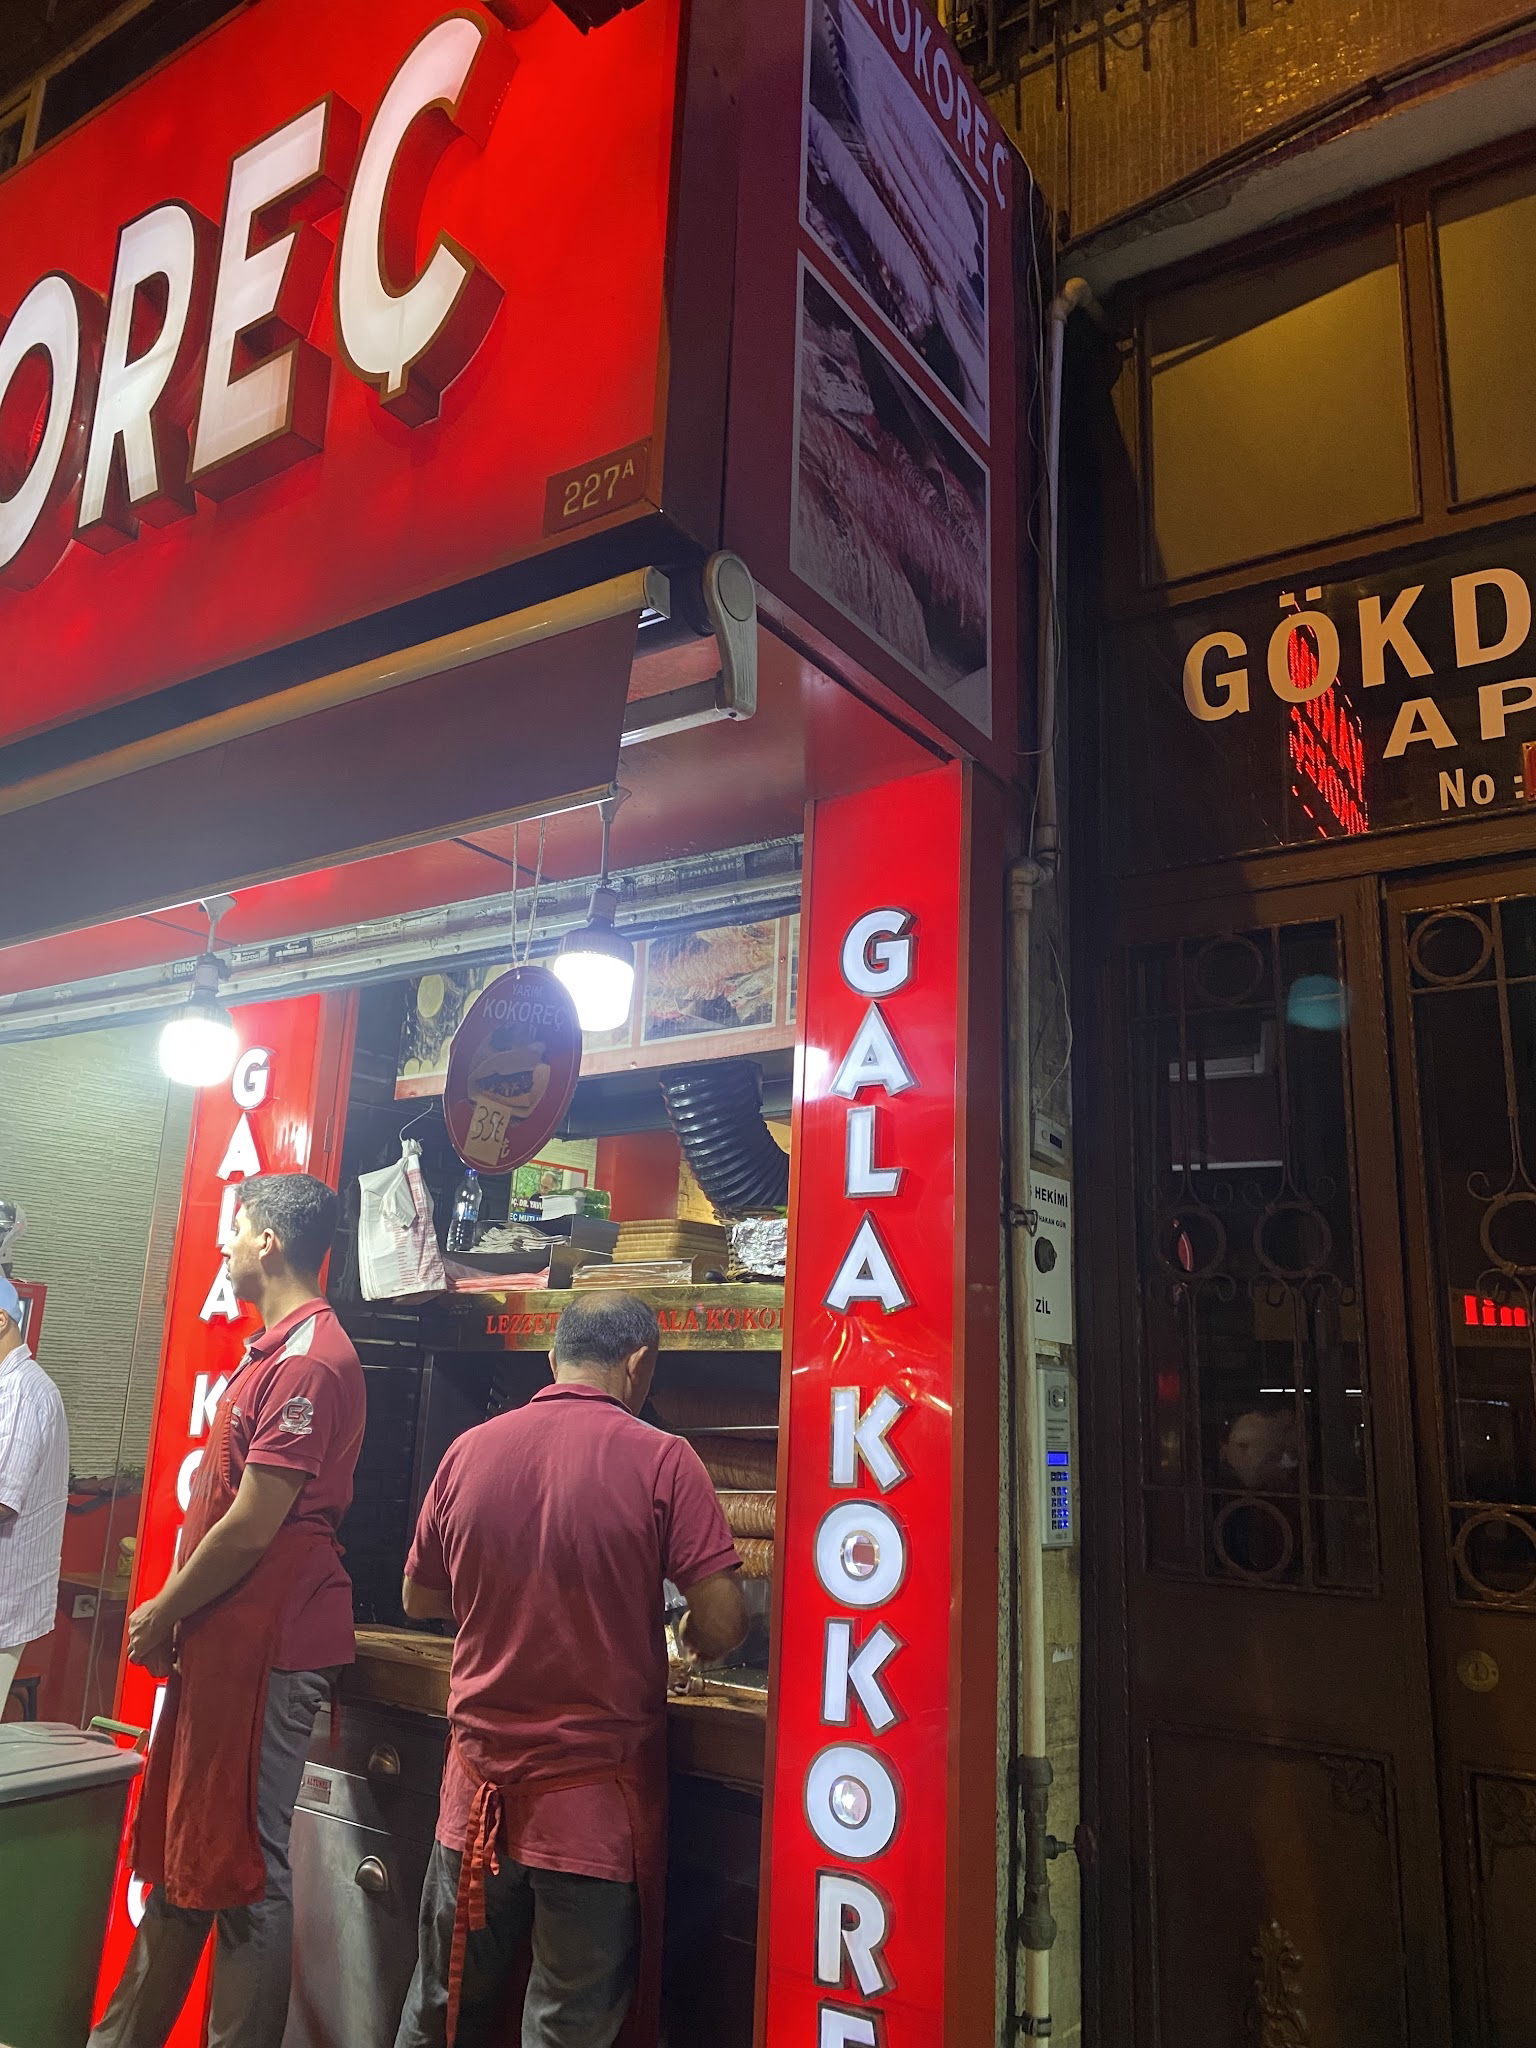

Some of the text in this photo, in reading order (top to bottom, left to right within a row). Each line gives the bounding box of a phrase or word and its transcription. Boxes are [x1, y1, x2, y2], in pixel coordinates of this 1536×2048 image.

[482, 998, 567, 1033] KOKOREÇ
[821, 906, 919, 1317] GALA
[1034, 1186, 1069, 1208] HEKİMİ
[1035, 1296, 1051, 1315] ZİL
